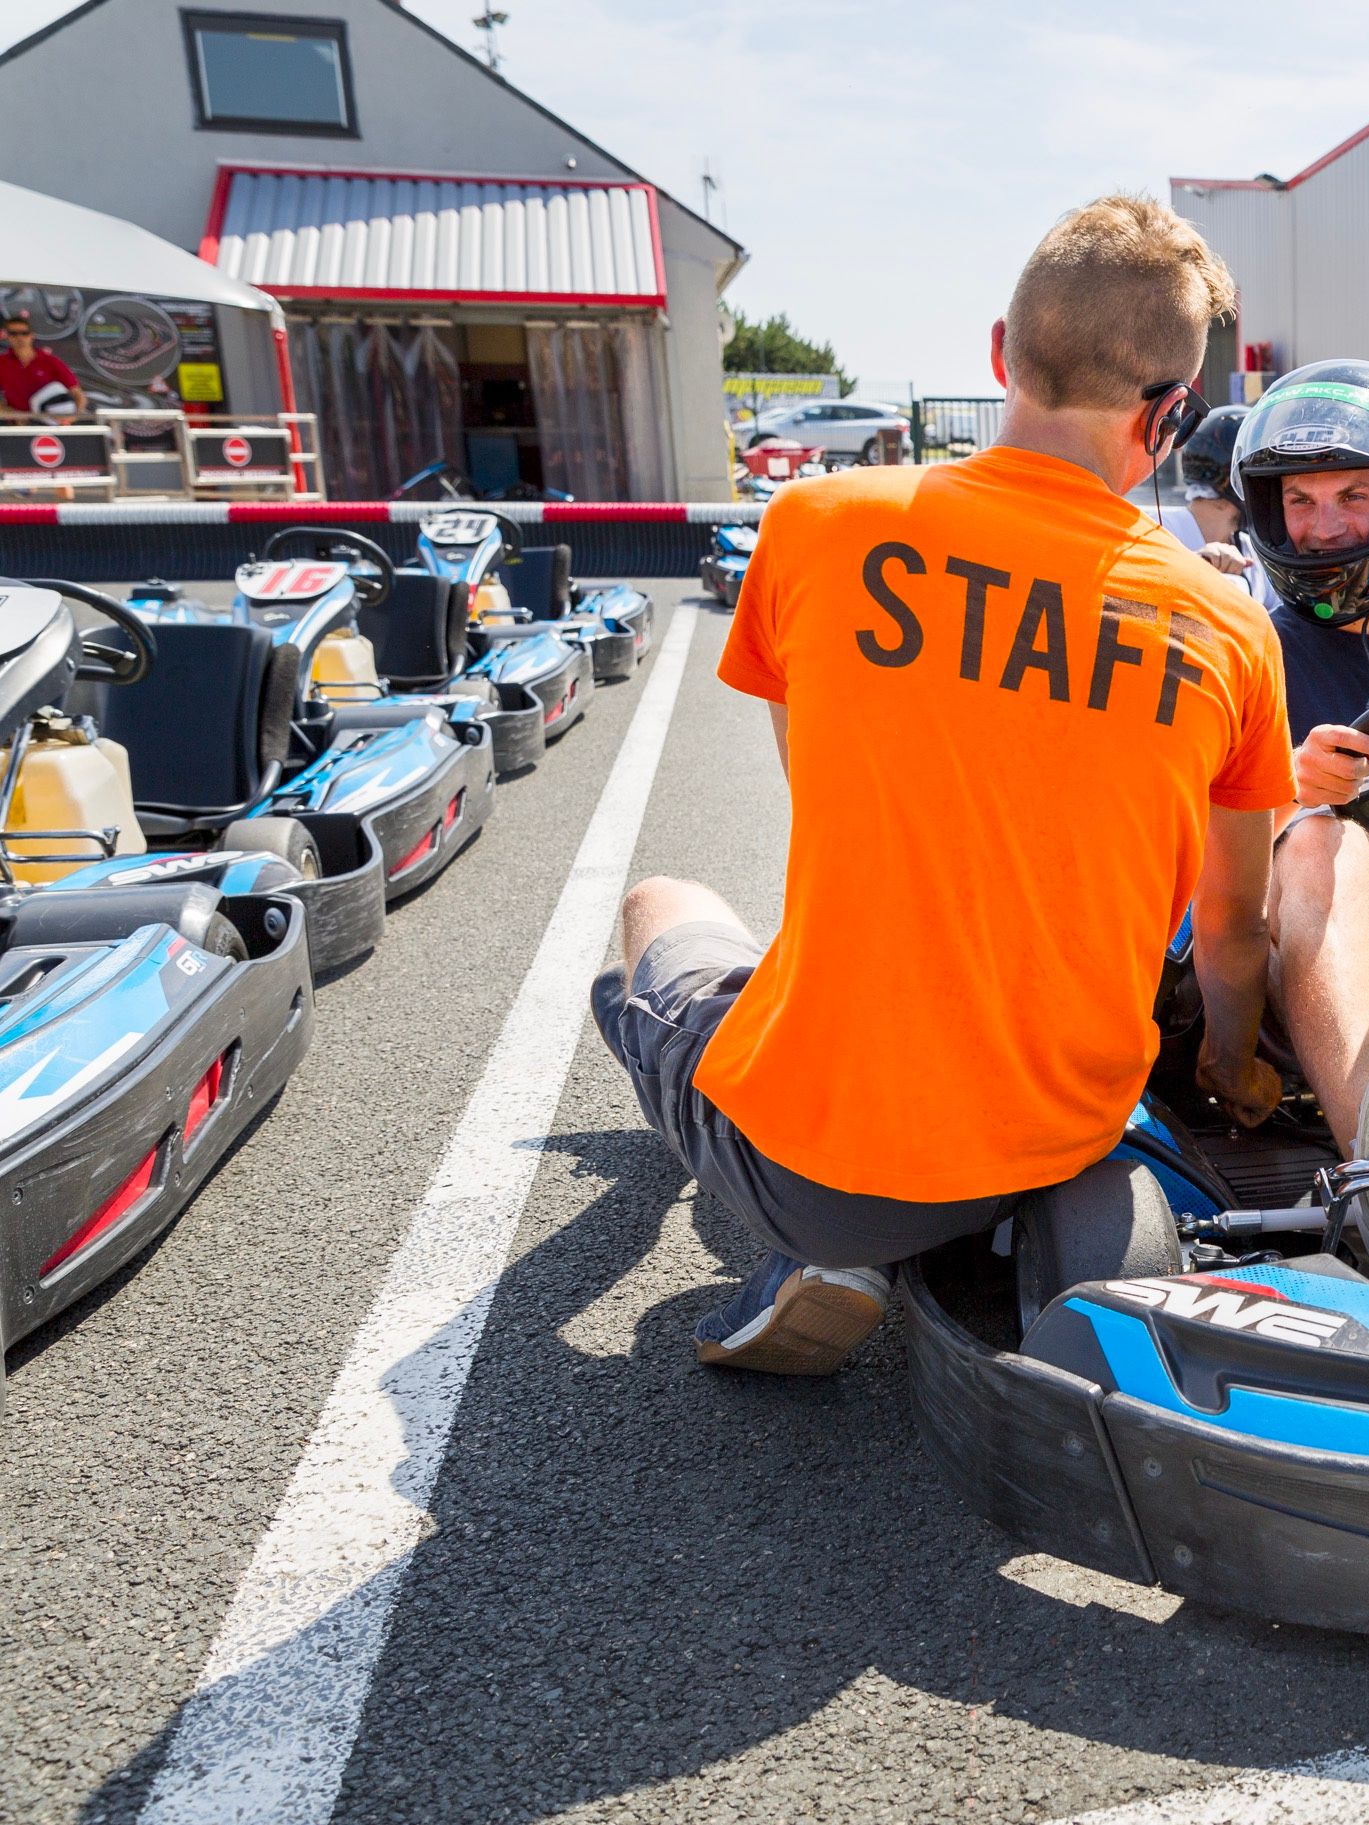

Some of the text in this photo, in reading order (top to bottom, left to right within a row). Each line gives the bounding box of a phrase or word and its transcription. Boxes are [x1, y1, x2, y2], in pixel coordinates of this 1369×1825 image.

[1279, 430, 1334, 445] HJC
[435, 519, 487, 538] 24
[259, 566, 335, 594] 16
[855, 541, 1230, 727] STAFF
[108, 850, 244, 886] SWS
[1104, 1279, 1347, 1348] SWS
